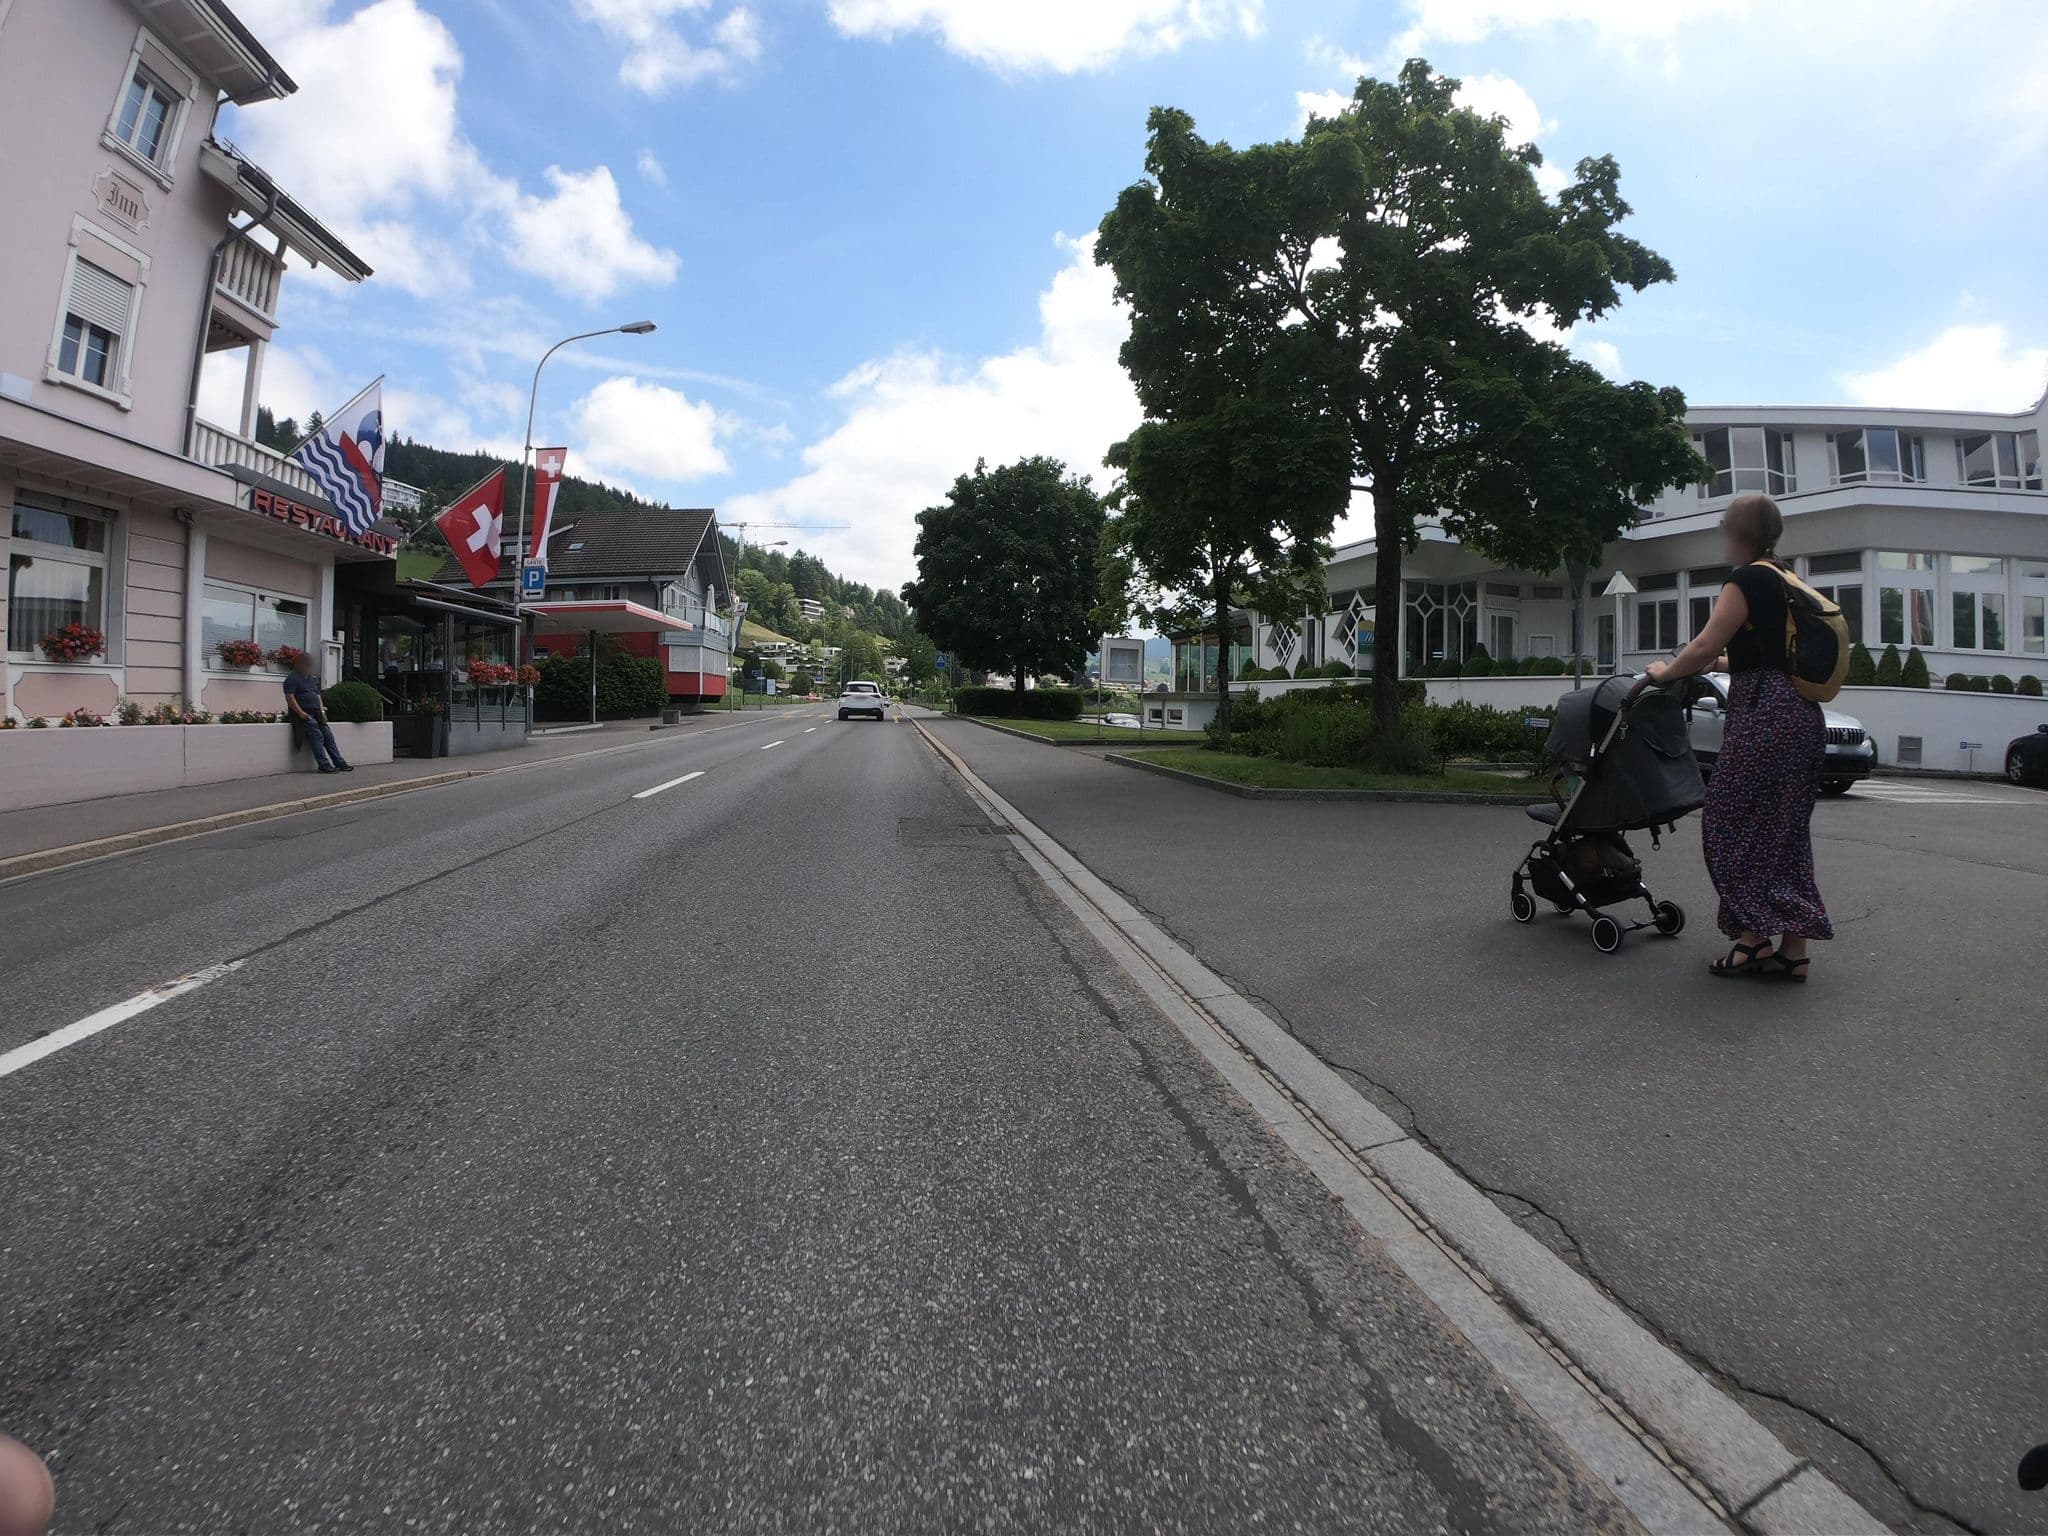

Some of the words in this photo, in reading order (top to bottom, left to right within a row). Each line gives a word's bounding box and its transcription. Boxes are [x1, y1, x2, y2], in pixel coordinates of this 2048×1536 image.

[106, 182, 139, 219] Inn
[251, 488, 397, 554] RESTAUANT
[529, 571, 539, 587] P
